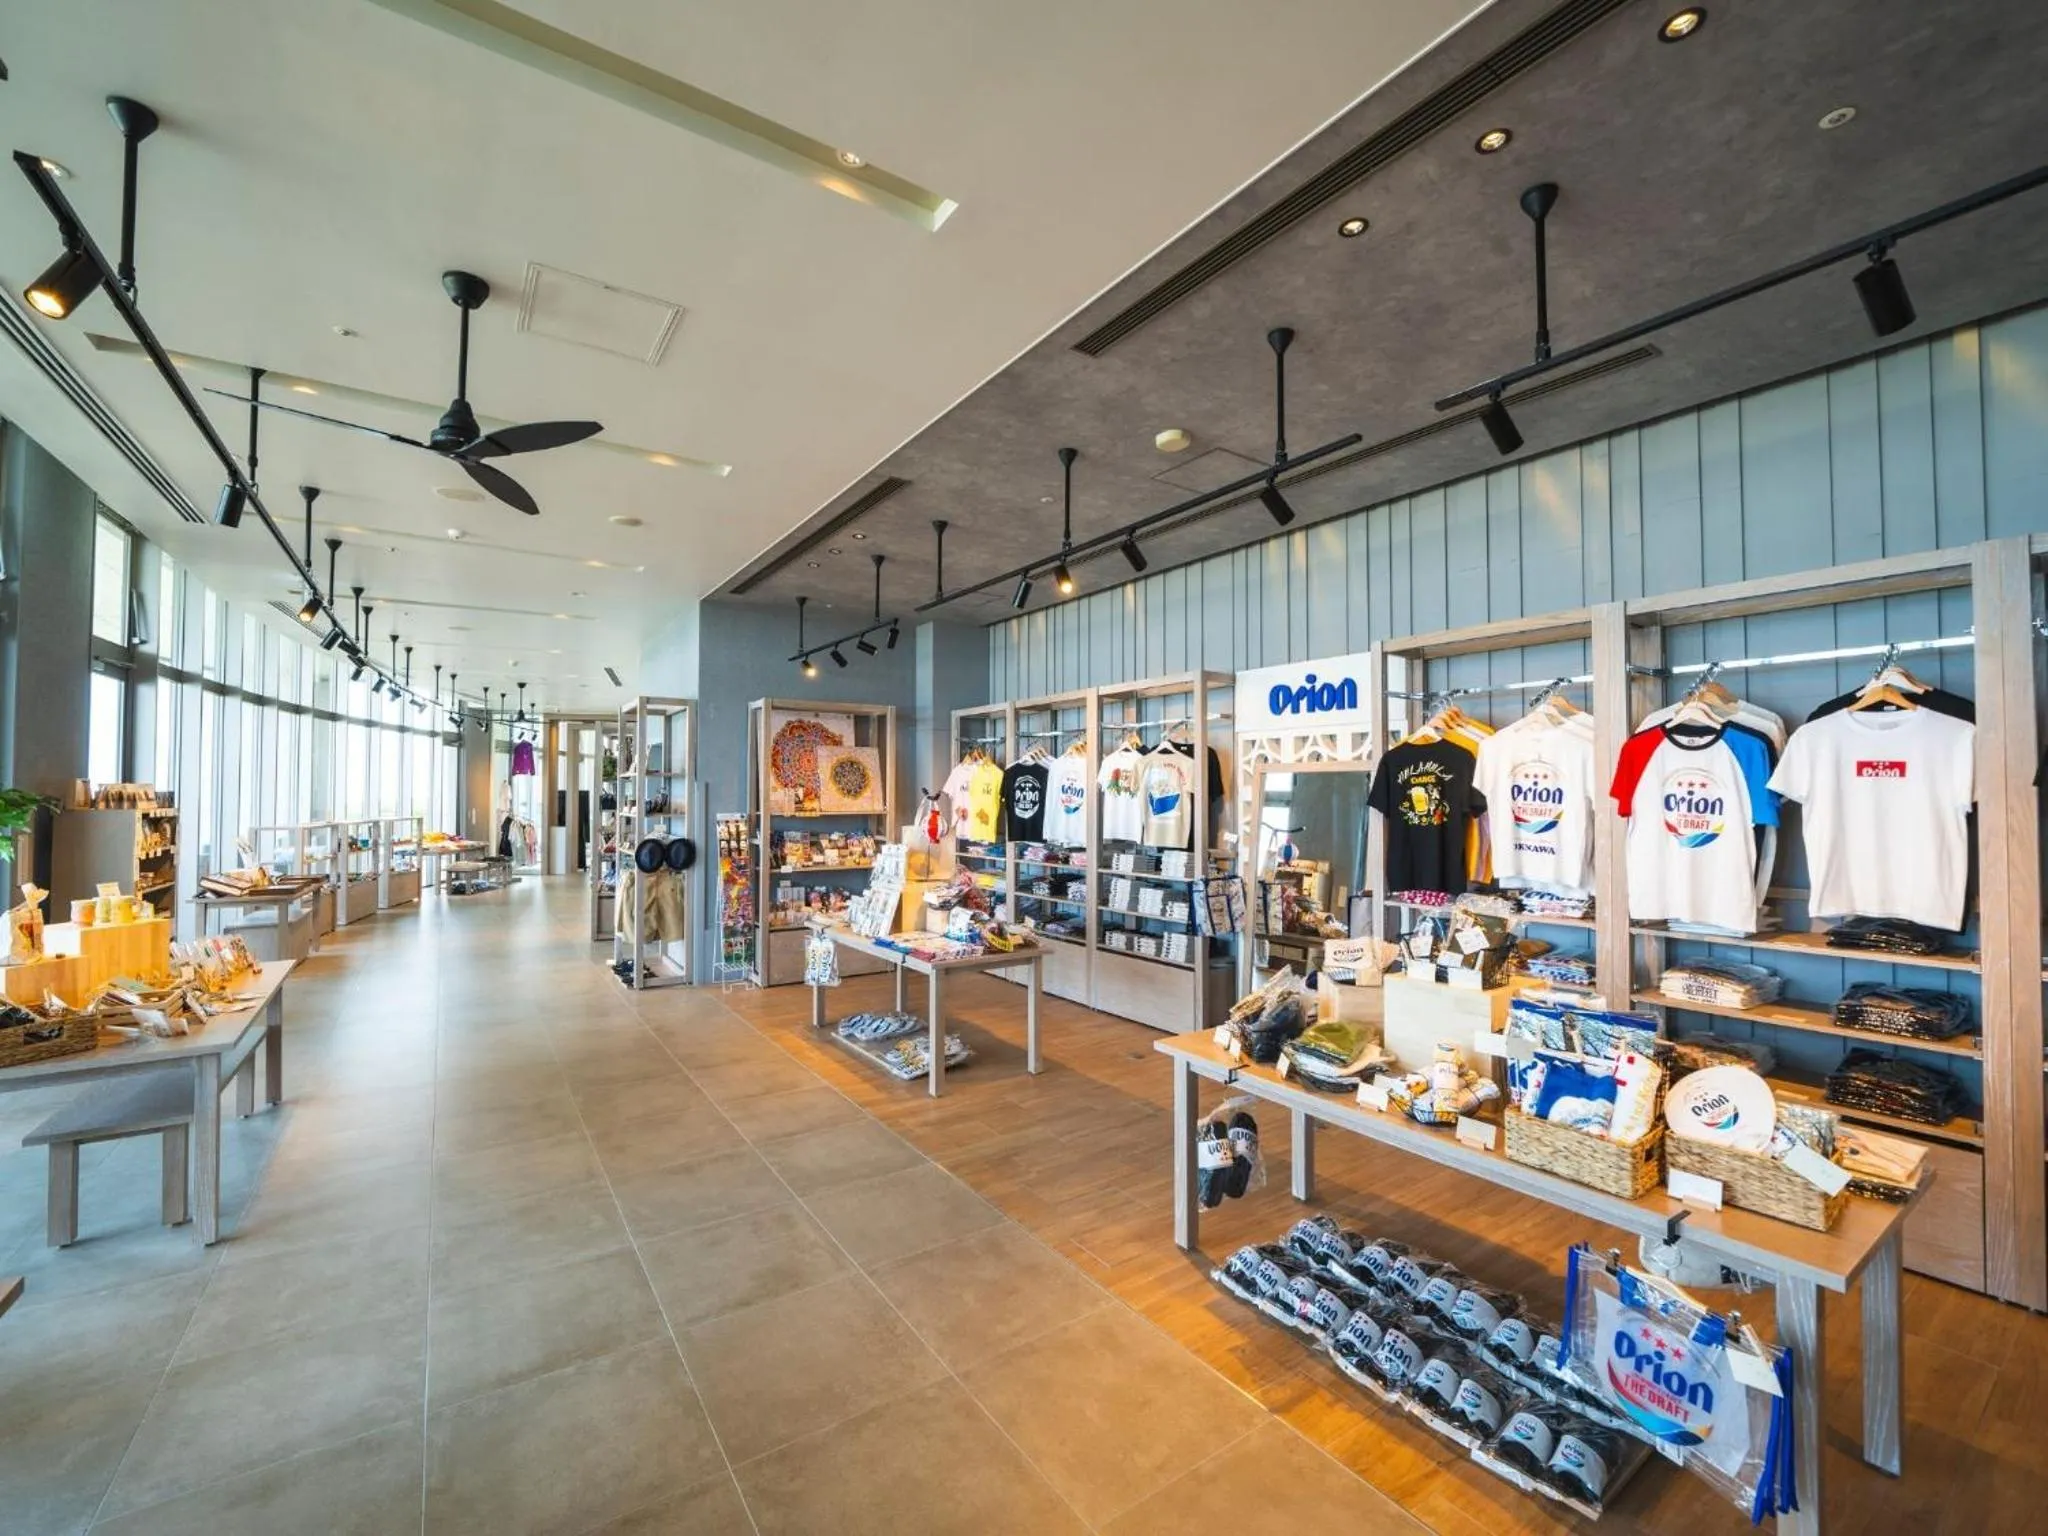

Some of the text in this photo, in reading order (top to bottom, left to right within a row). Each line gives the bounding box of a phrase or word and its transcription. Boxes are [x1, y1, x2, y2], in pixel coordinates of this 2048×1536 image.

[1269, 673, 1358, 716] Orion
[1511, 780, 1564, 804] Orion
[1664, 790, 1724, 816] Orion
[1691, 1094, 1730, 1117] Orion
[1391, 1264, 1419, 1291] rion
[1381, 1338, 1413, 1369] rion
[1613, 1330, 1714, 1415] Orion
[1648, 1389, 1689, 1423] DRAFT
